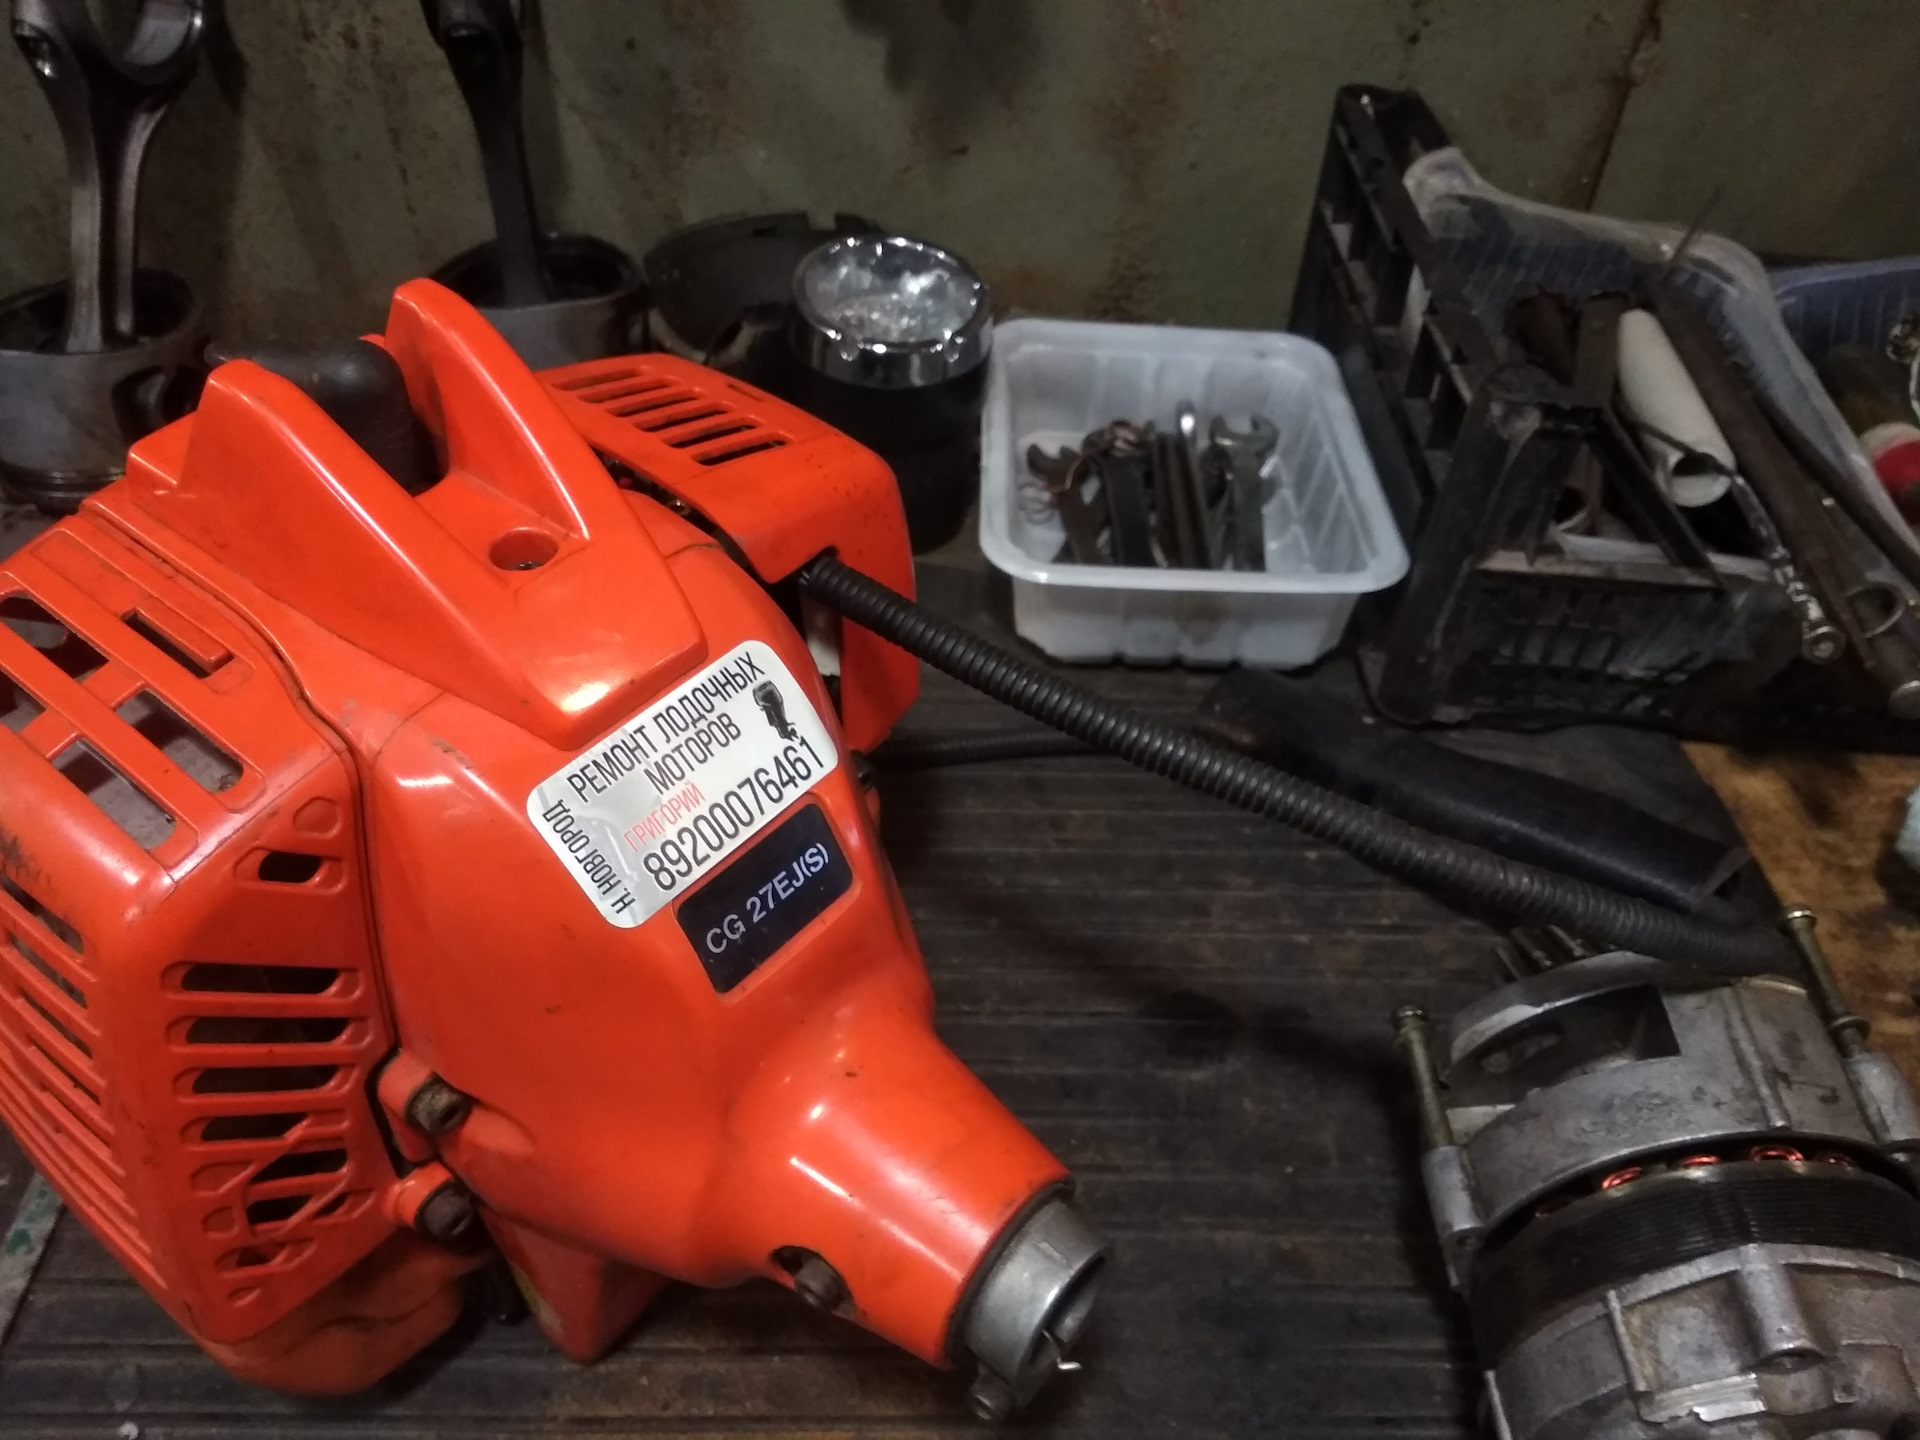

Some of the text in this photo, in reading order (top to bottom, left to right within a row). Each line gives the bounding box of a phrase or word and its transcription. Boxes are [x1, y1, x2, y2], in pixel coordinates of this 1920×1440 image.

[566, 651, 765, 803] РЕМОНТ ЛОДОЧНЫХ
[643, 713, 742, 796] МОТОРОВ
[542, 799, 620, 896] НОВГОРОД
[623, 782, 706, 851] ГРИГОРИЙ
[643, 739, 824, 891] 89200076461
[706, 843, 830, 954] CG 27EJ(S)
